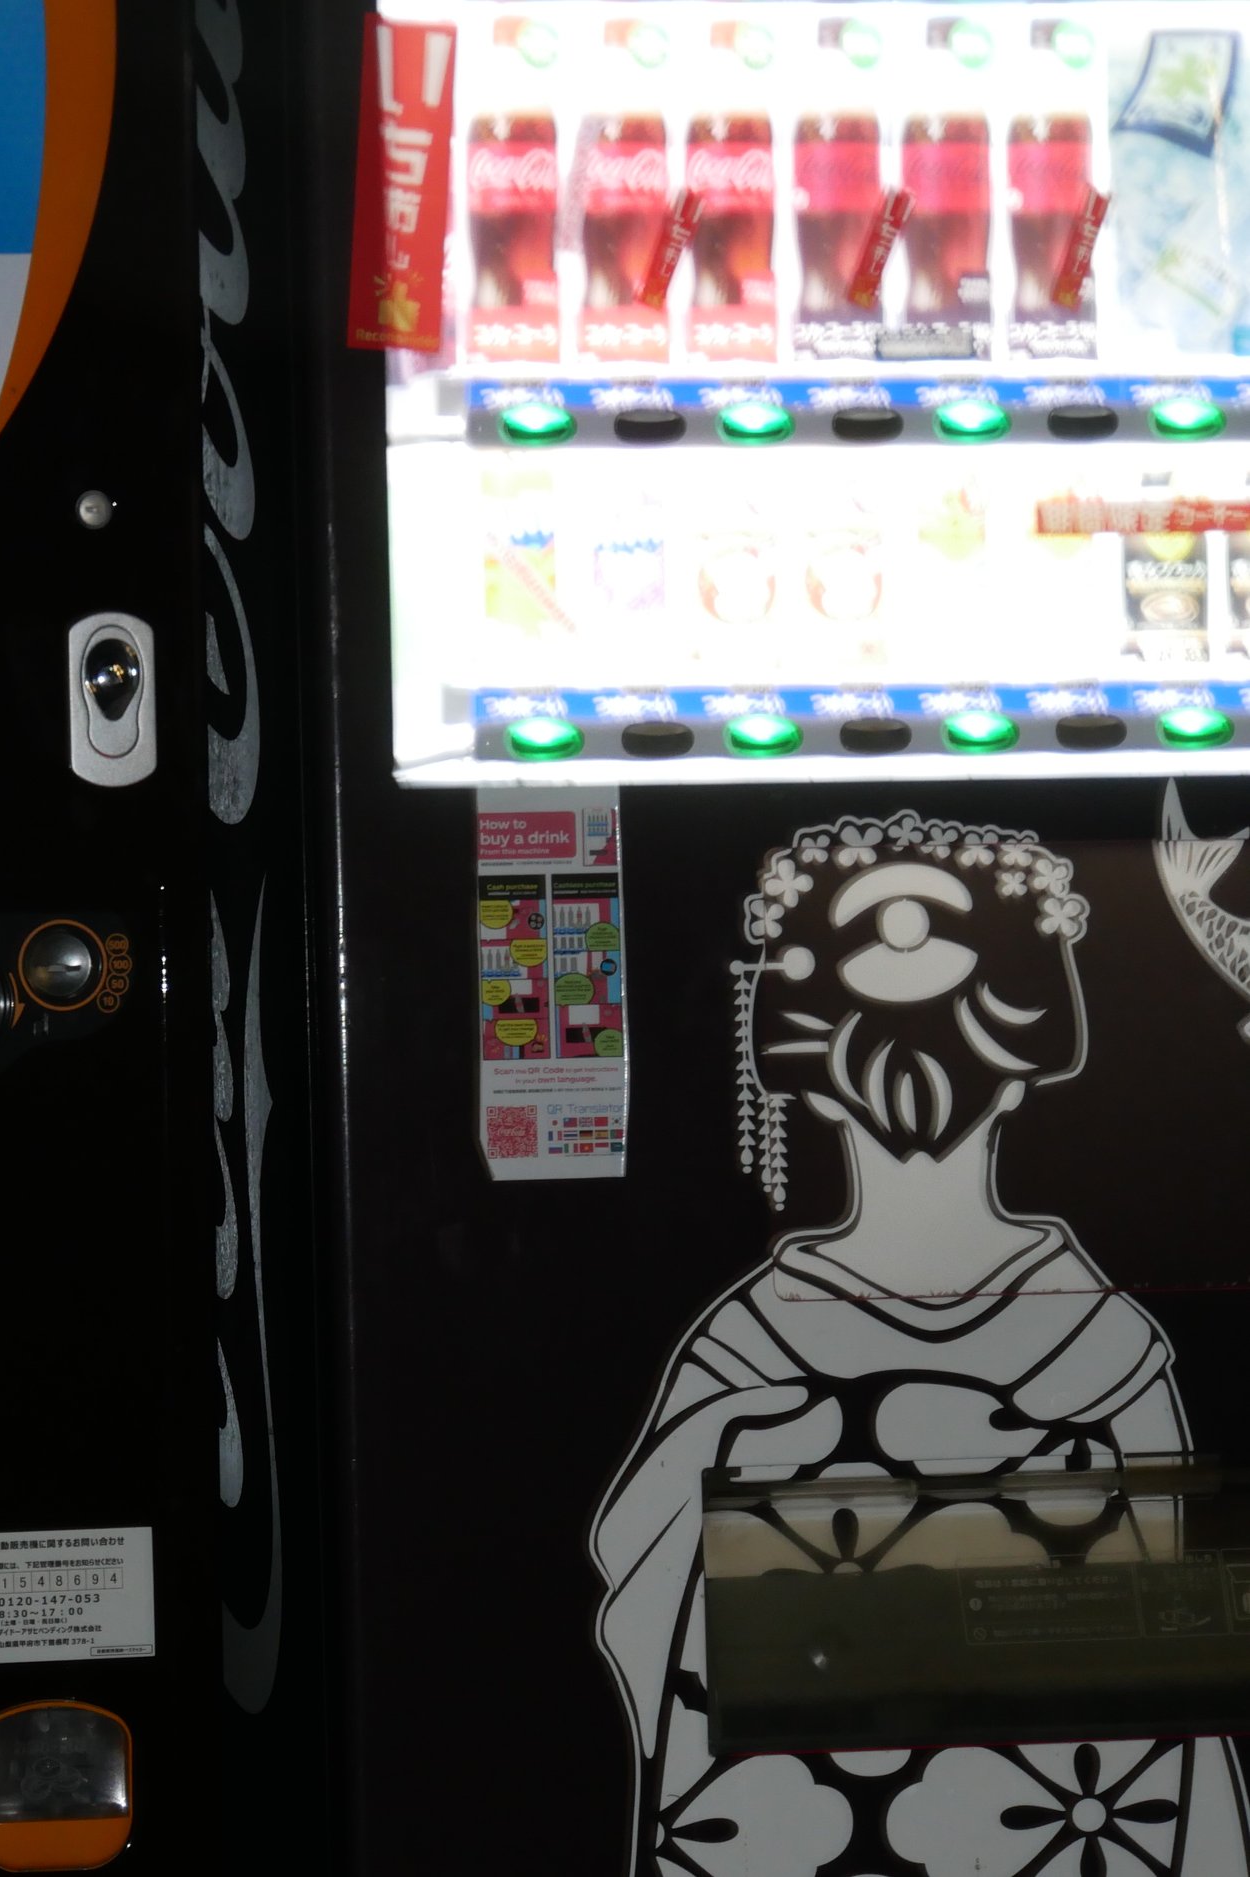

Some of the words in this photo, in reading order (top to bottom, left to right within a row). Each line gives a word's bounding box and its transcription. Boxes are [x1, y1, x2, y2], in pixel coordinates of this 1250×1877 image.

[479, 819, 510, 831] How
[513, 819, 527, 830] to
[479, 832, 511, 848] buy
[513, 834, 525, 845] a
[527, 830, 570, 845] drink
[518, 847, 550, 855] machine
[486, 883, 504, 891] Cash
[505, 882, 539, 892] purchase
[108, 941, 127, 950] 500
[111, 960, 130, 969] 100
[493, 1067, 514, 1076] Scan
[528, 1067, 540, 1076] QR
[543, 1066, 565, 1075] Code
[547, 1104, 563, 1115] QR
[567, 1103, 624, 1115] Translator
